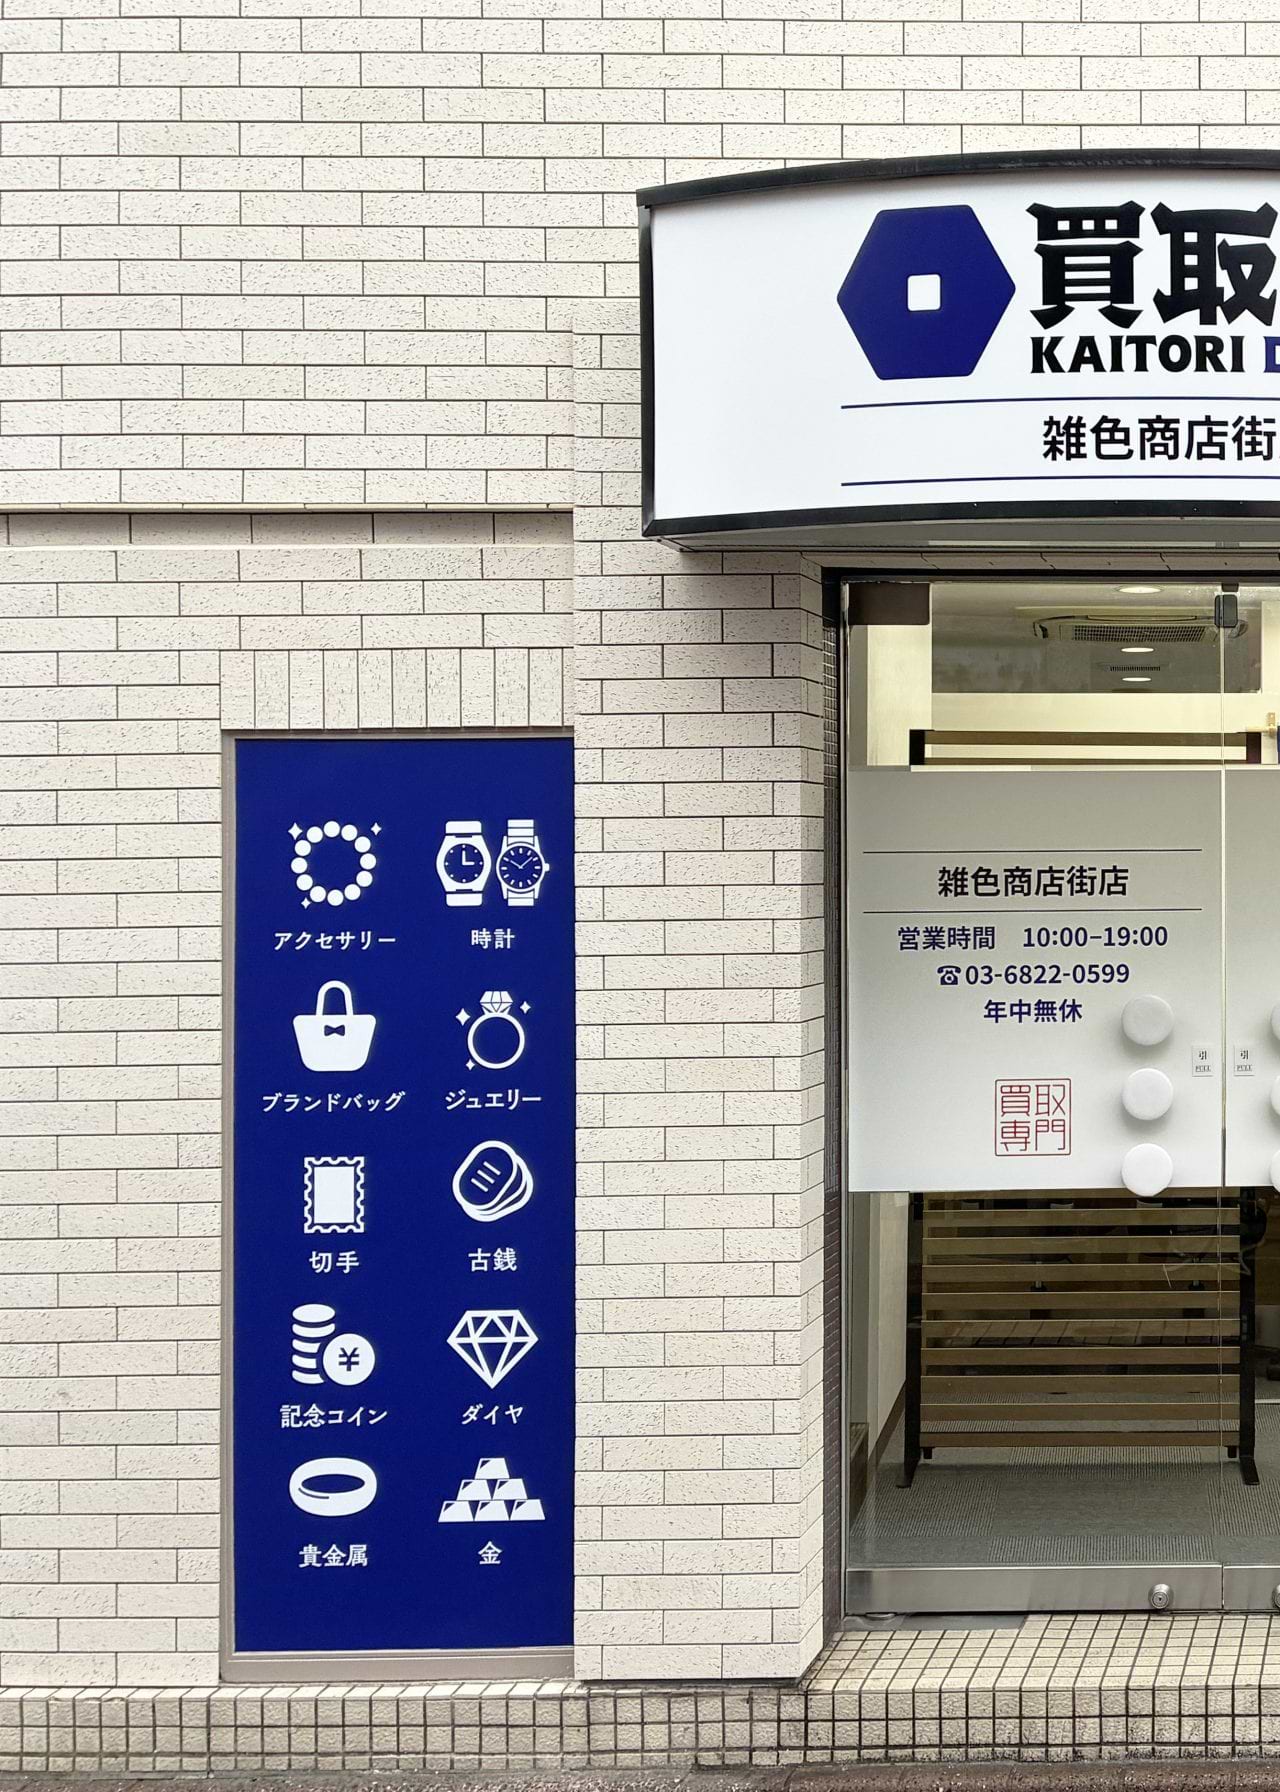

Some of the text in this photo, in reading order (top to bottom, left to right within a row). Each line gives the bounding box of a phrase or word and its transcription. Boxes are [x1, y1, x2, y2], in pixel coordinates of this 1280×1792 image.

[1030, 334, 1246, 374] KAITORI
[937, 864, 1129, 898] 雑色商店街店
[274, 930, 396, 951] アクセサリー
[471, 927, 515, 950] 時計
[897, 925, 996, 951] 営業時間
[965, 963, 1130, 986] 03-6822-0599
[983, 998, 1083, 1024] 年中無休
[262, 1090, 406, 1113] ブランドバッグ
[445, 1088, 542, 1110] ジュエリー
[999, 1083, 1067, 1118] 買取
[999, 1118, 1067, 1153] 専門
[308, 1250, 360, 1274] 切手
[468, 1247, 517, 1272] 古銭
[279, 1403, 388, 1429] 記念コイン
[461, 1403, 524, 1425] ダイヤ
[299, 1543, 368, 1568] 貴金属
[478, 1541, 502, 1565] 金
